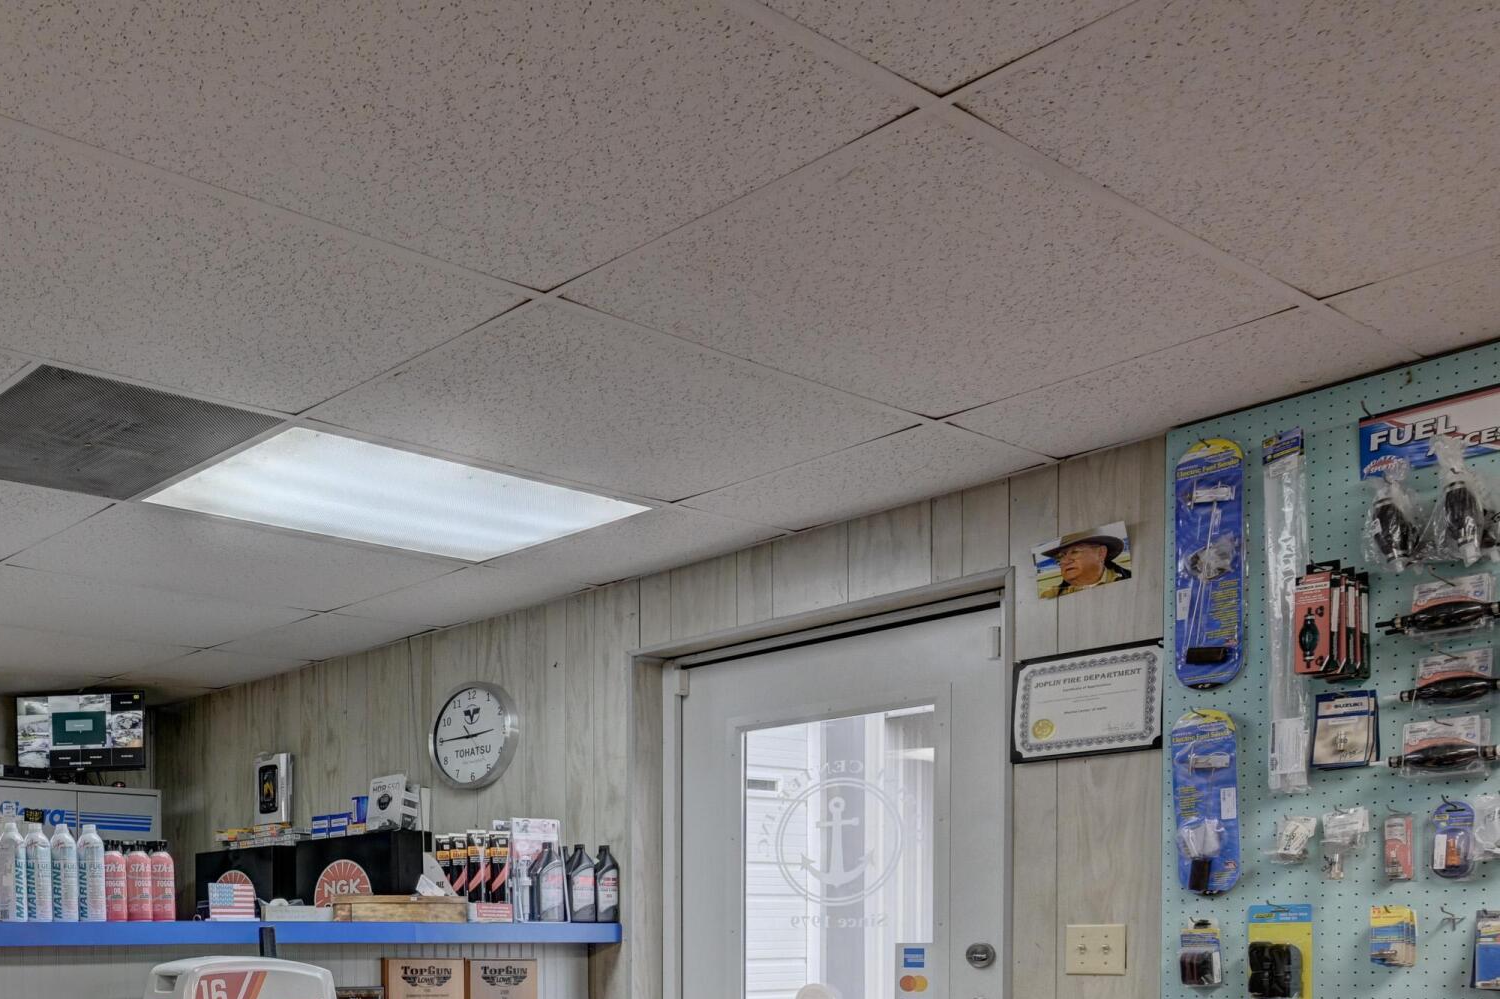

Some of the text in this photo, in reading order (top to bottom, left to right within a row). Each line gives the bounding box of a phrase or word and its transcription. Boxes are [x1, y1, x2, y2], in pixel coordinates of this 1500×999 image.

[1369, 415, 1457, 452] FUEL
[1202, 463, 1217, 473] Fuel
[1034, 680, 1061, 688] JOPLIN
[1063, 677, 1082, 685] FIRE
[1084, 668, 1142, 682] DEPARTMENT
[467, 690, 477, 700] 12
[486, 692, 491, 701] 1
[453, 699, 461, 709] 11
[497, 706, 503, 715] 2
[443, 717, 452, 727] 10
[455, 744, 491, 759] TOHATSU
[443, 756, 449, 765] 8
[486, 763, 491, 773] 5
[455, 769, 460, 779] 7
[470, 772, 476, 781] 6
[14, 859, 24, 919] MARINE
[26, 860, 37, 919] MARINE
[52, 860, 63, 919] MARINE
[78, 861, 89, 919] MARINE
[323, 877, 361, 898] NGK
